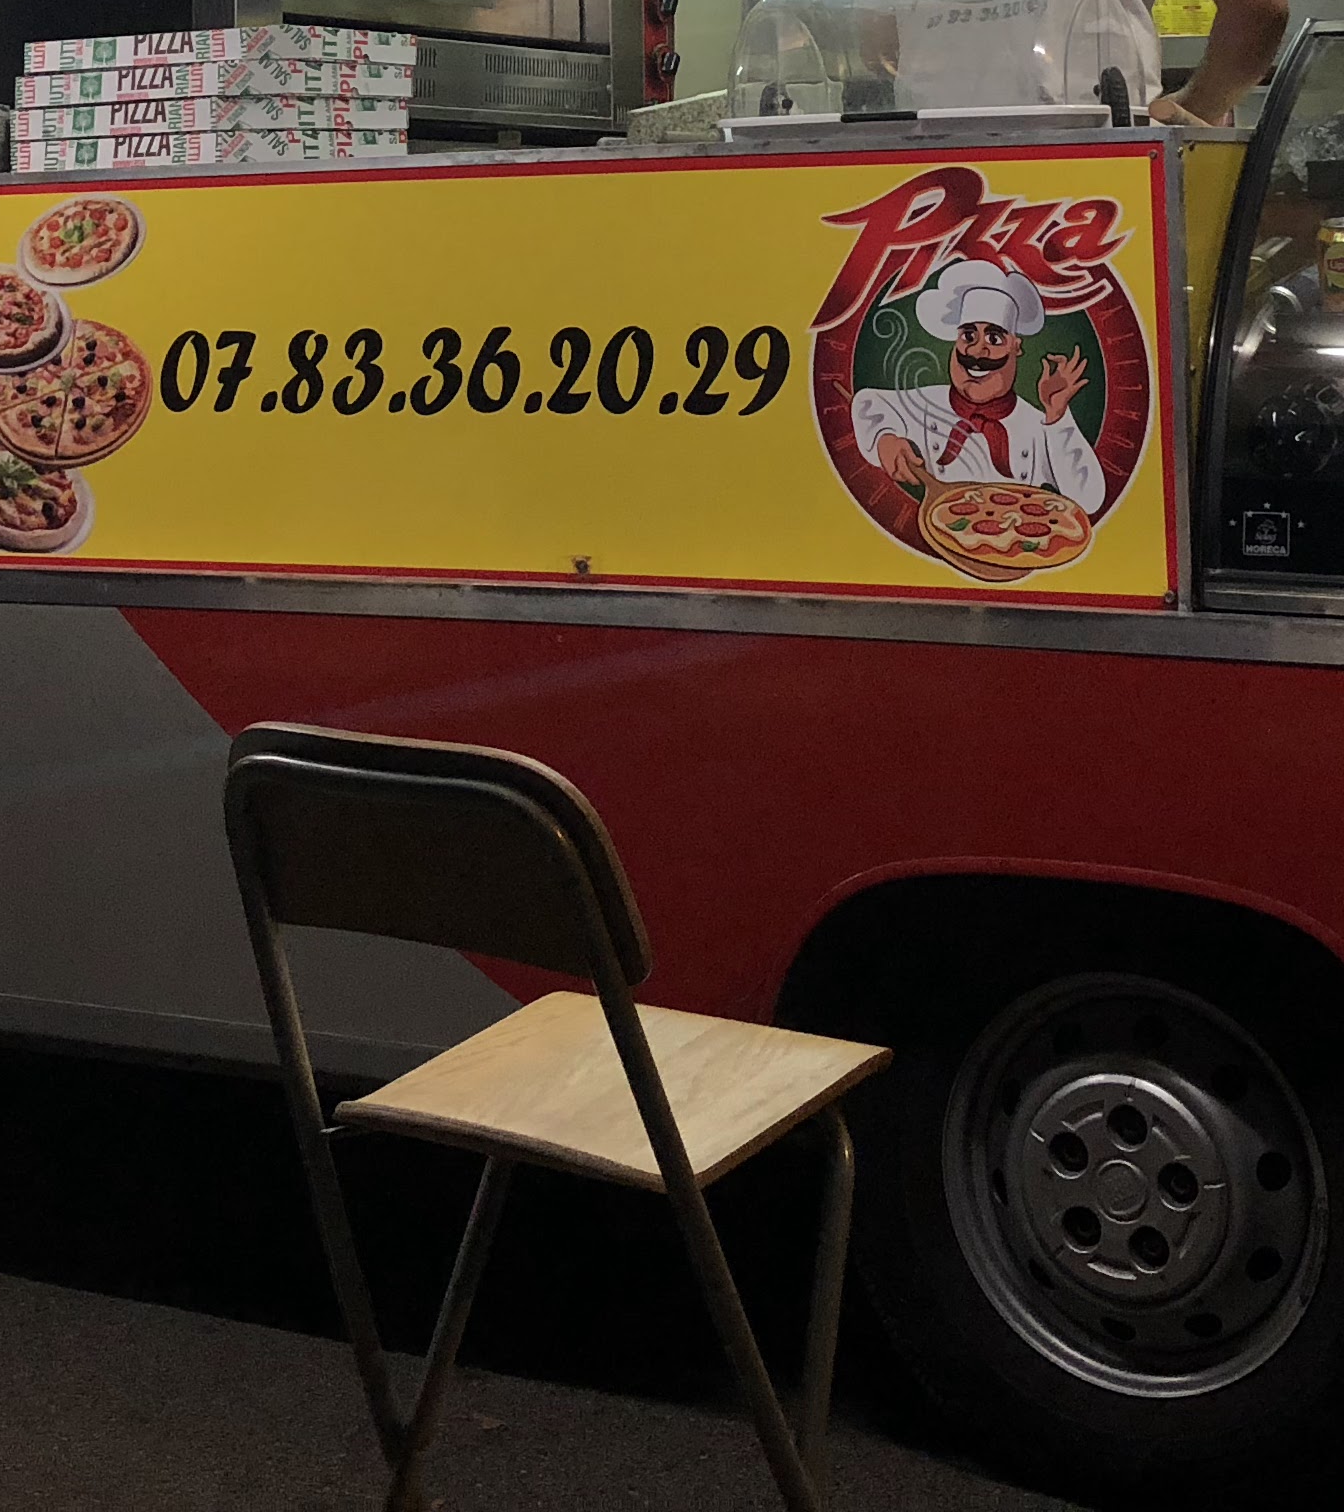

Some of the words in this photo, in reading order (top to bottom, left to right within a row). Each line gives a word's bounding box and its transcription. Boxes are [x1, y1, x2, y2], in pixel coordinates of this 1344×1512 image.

[133, 31, 194, 56] PIZZA
[117, 66, 173, 91] PIZZA
[110, 101, 167, 125] PIZZA
[113, 135, 171, 159] PIZZA
[810, 165, 1138, 333] Pizza
[159, 324, 790, 417] 07.83.36.20.29
[1246, 545, 1286, 553] HORECA
